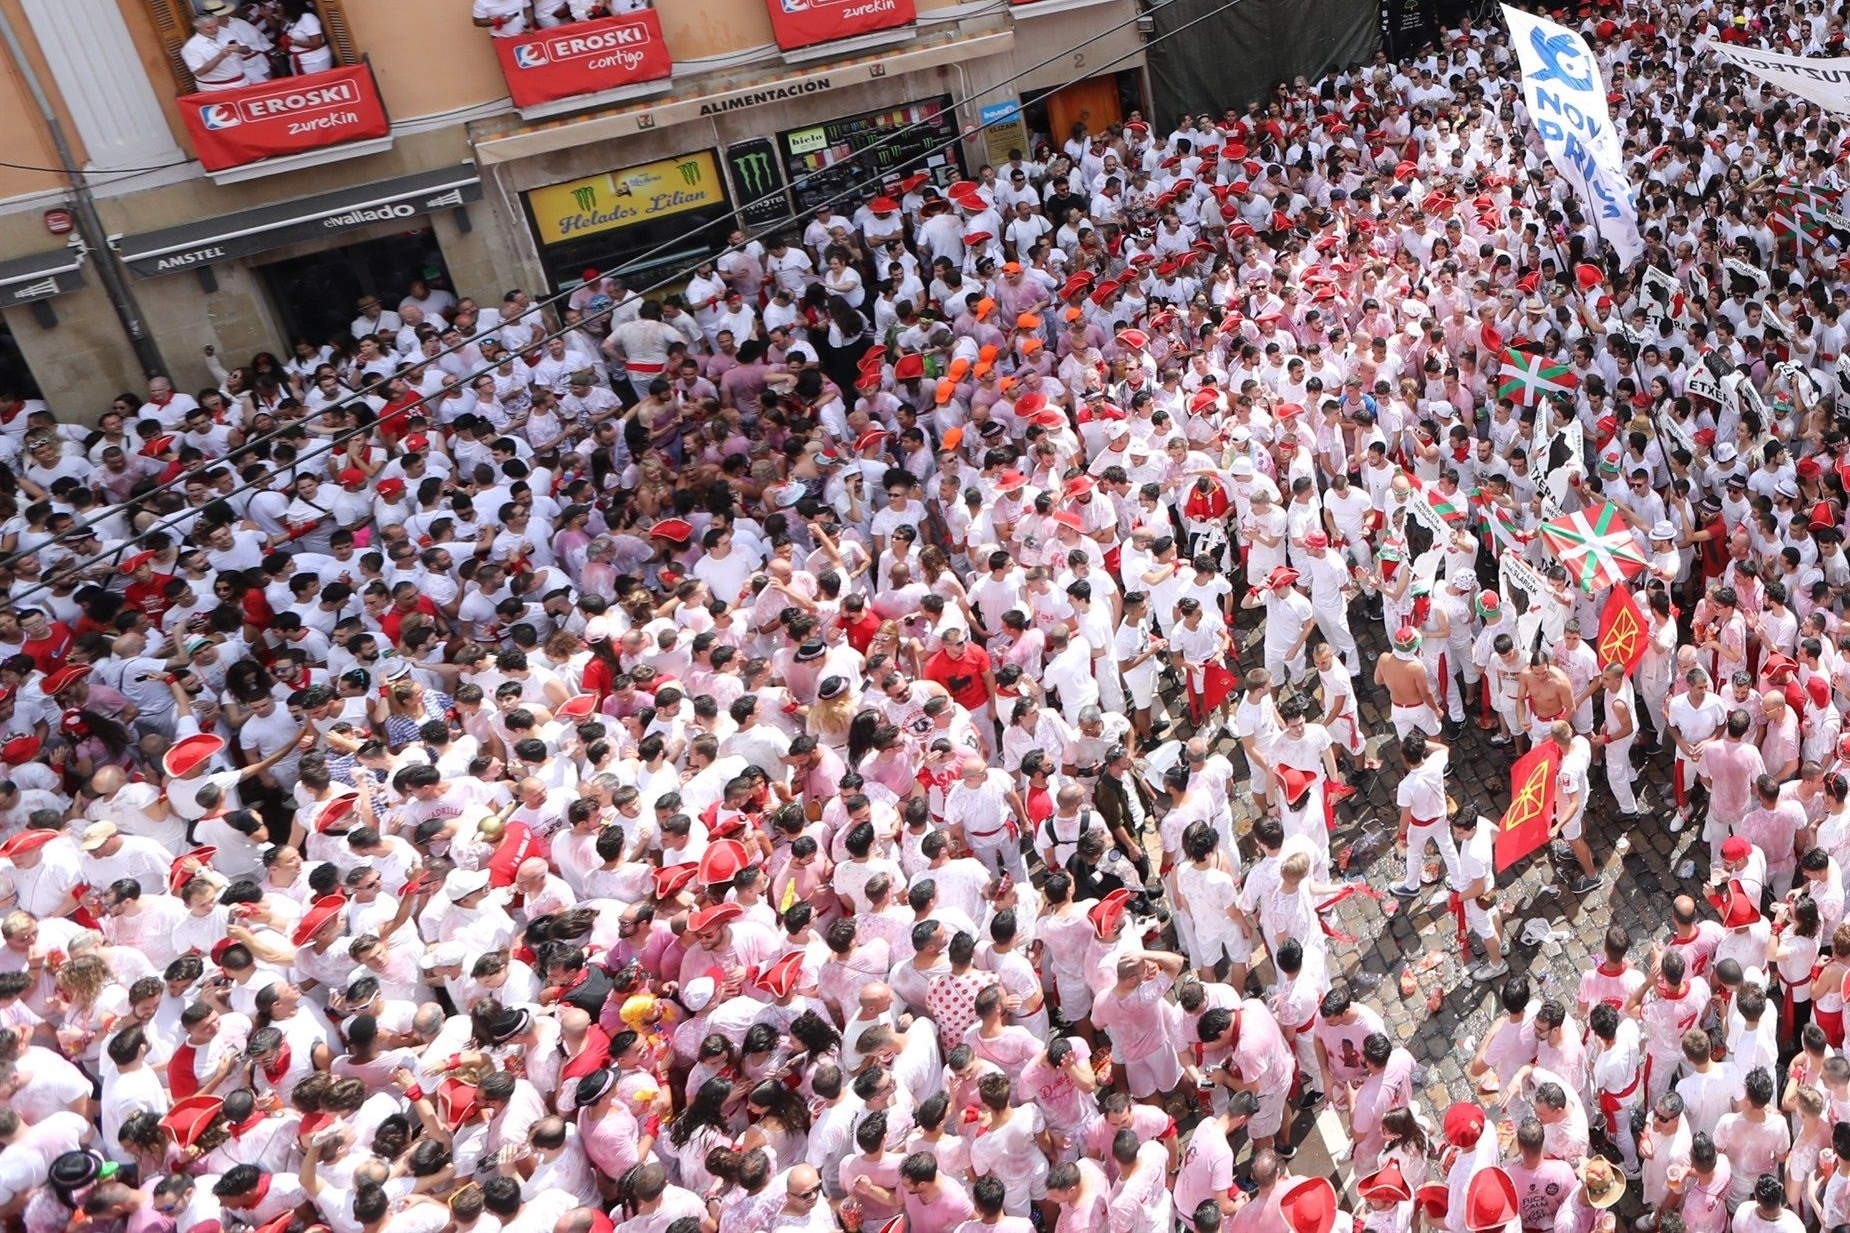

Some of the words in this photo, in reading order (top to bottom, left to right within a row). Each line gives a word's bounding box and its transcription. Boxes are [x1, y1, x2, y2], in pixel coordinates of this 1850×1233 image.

[556, 25, 643, 57] EROSKI
[589, 49, 645, 71] contigo
[1073, 53, 1086, 69] 2
[248, 84, 352, 117] EROSKI
[700, 78, 831, 116] ALIMENTACIÓN
[288, 111, 358, 135] zurekin
[558, 206, 638, 235] Helados
[645, 190, 706, 214] Lilian
[158, 246, 224, 271] AMSTEL
[1677, 1010, 1700, 1040] 7
